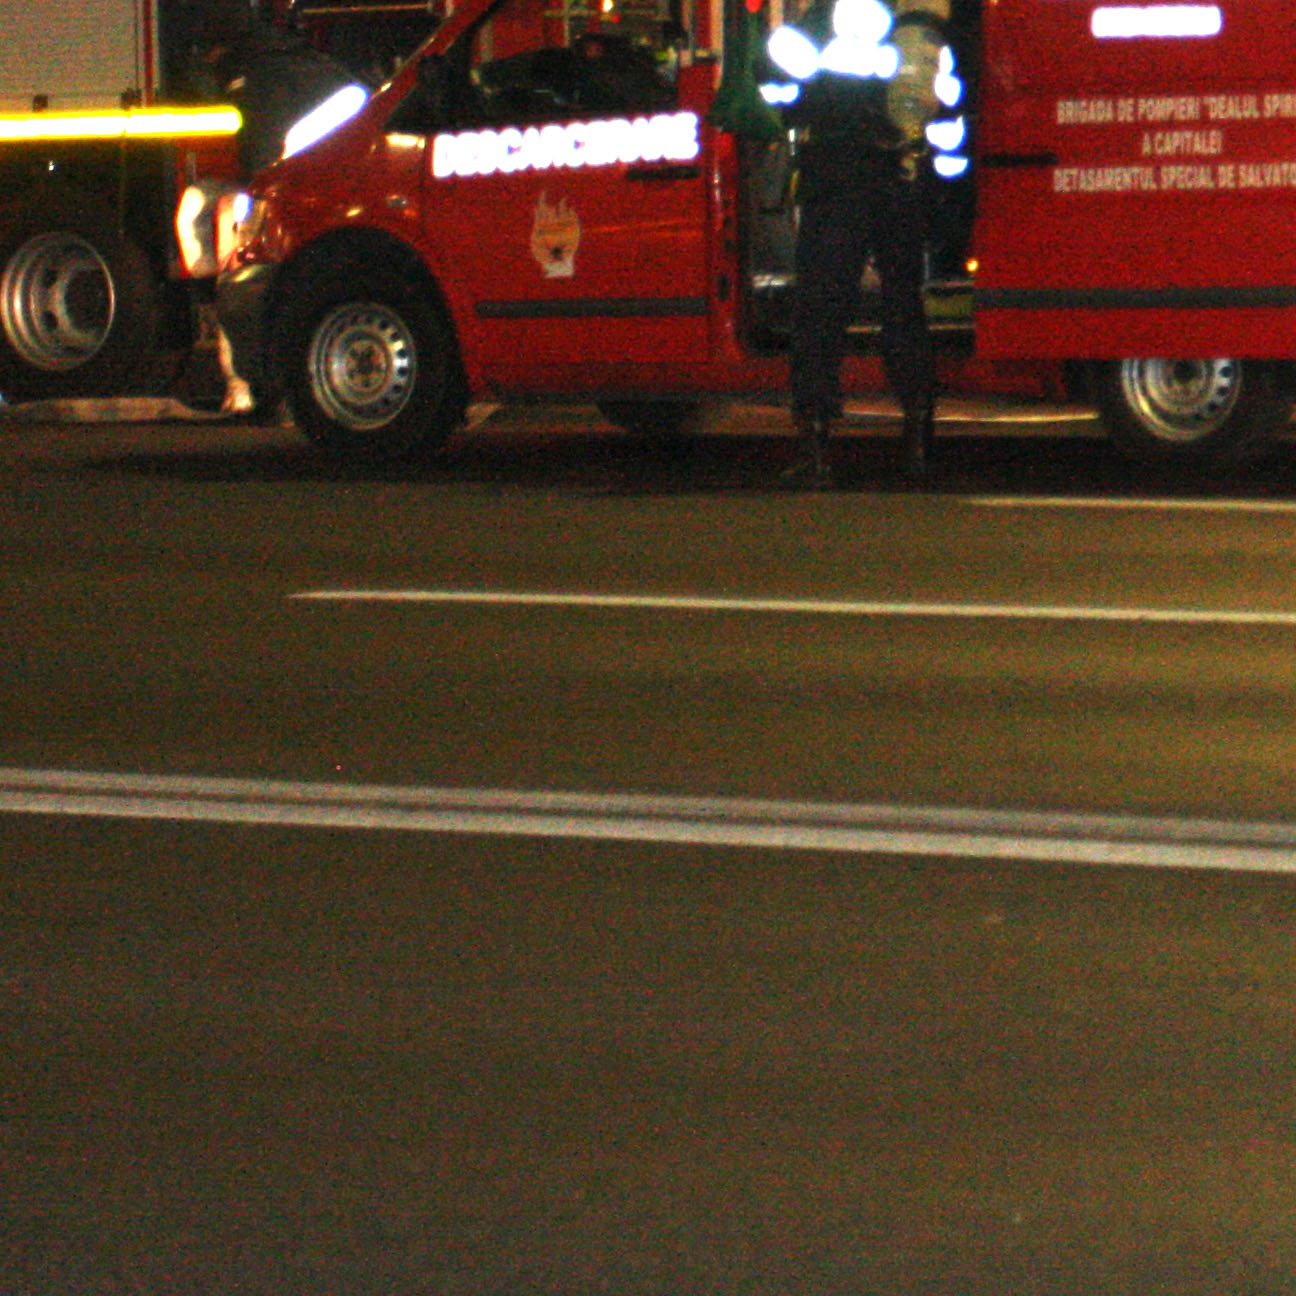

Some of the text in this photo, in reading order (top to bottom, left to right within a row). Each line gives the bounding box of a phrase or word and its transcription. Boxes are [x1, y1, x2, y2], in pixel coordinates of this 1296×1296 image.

[1057, 98, 1114, 124] BRIGADA
[1117, 97, 1135, 122] DE
[1142, 130, 1223, 155] A CAPITALEI
[1160, 164, 1215, 190] SPECIAL
[1218, 163, 1237, 188] DE
